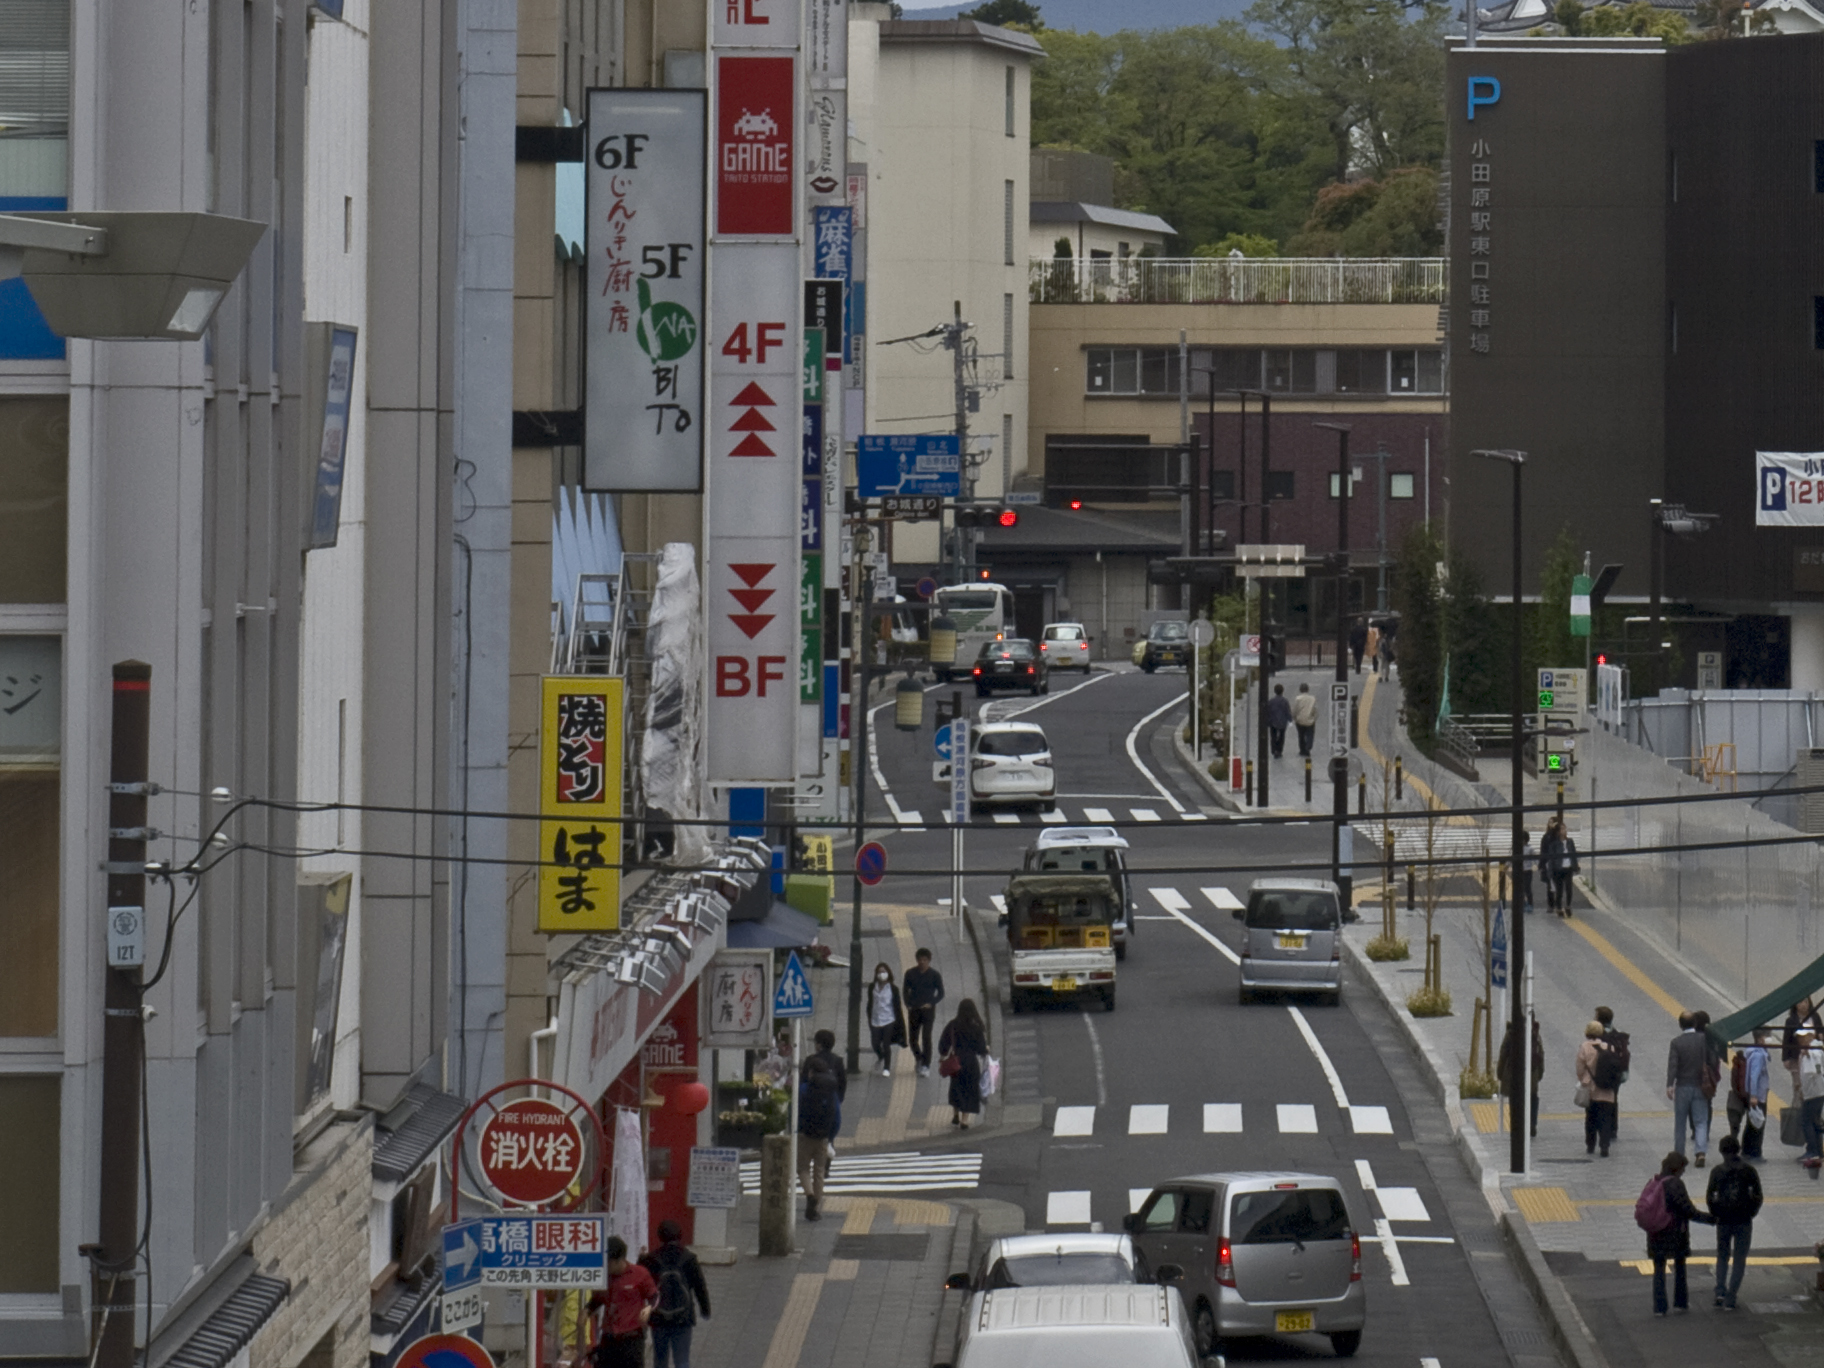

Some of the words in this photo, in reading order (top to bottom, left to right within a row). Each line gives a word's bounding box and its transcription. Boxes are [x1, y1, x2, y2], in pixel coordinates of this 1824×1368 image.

[1467, 76, 1501, 120] P
[594, 133, 650, 170] 6F
[724, 143, 788, 172] GAME
[639, 243, 693, 279] 5F
[818, 218, 850, 273] 麻雀
[1470, 138, 1491, 353] 小田原駅東口駐車場
[722, 322, 787, 364] 4F
[886, 498, 937, 510] お城通り
[716, 656, 786, 697] BF
[559, 695, 605, 801] 焼とり
[554, 825, 606, 914] はま
[499, 1112, 519, 1124] FIRE
[523, 1113, 566, 1125] HYDRANT
[489, 1130, 575, 1172] 消火栓
[502, 1254, 568, 1266] クリニック
[536, 1268, 601, 1283] 天野ビル3F
[444, 1294, 480, 1325] ここから
